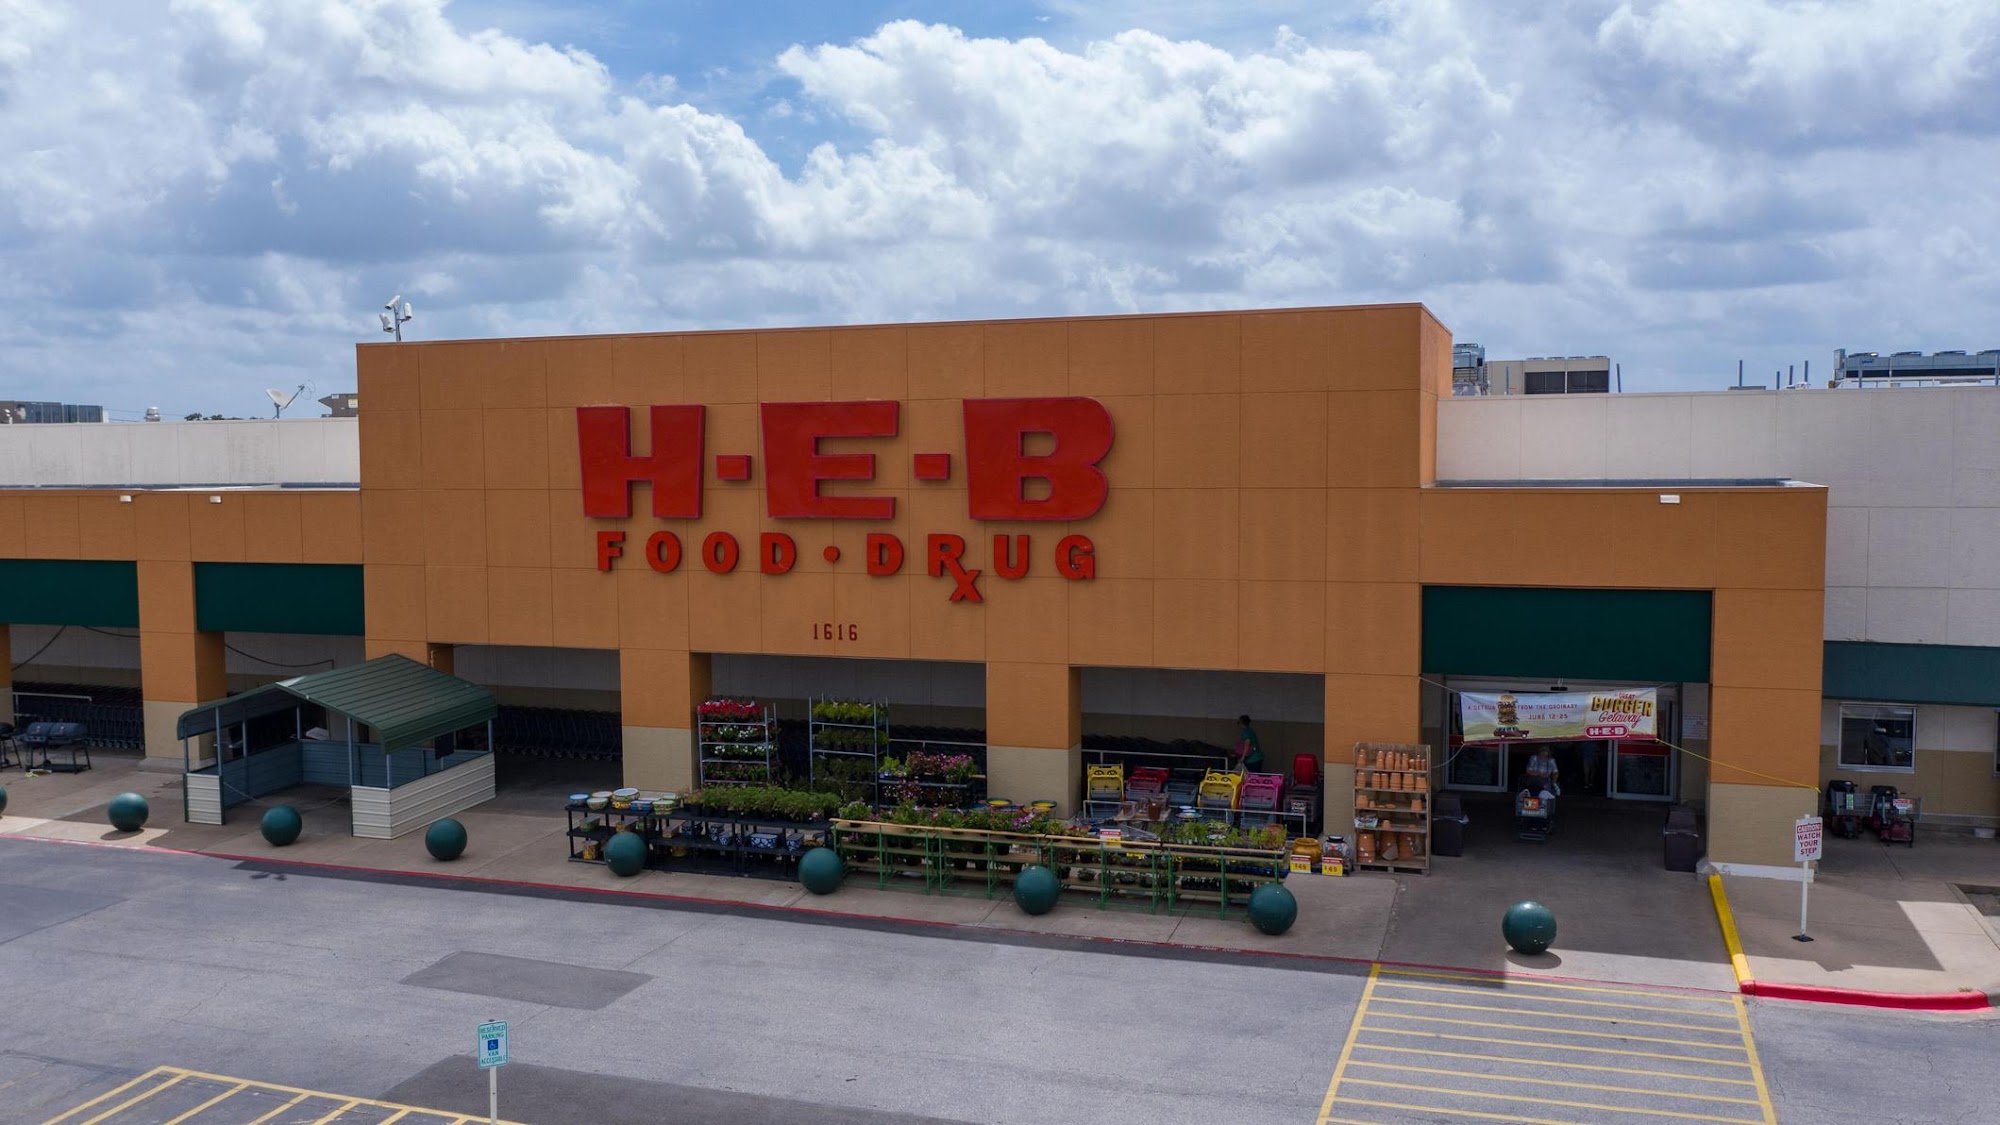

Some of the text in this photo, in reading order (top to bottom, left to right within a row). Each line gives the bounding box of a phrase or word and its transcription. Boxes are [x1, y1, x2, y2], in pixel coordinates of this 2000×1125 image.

[597, 531, 797, 575] FOOD
[813, 623, 858, 641] 1616
[1591, 695, 1653, 717] BURGER
[1598, 710, 1642, 729] Getaway
[1798, 832, 1820, 840] WATCH
[1800, 840, 1818, 848] YOUR
[1800, 847, 1817, 855] STEP
[482, 1032, 504, 1040] PARKING
